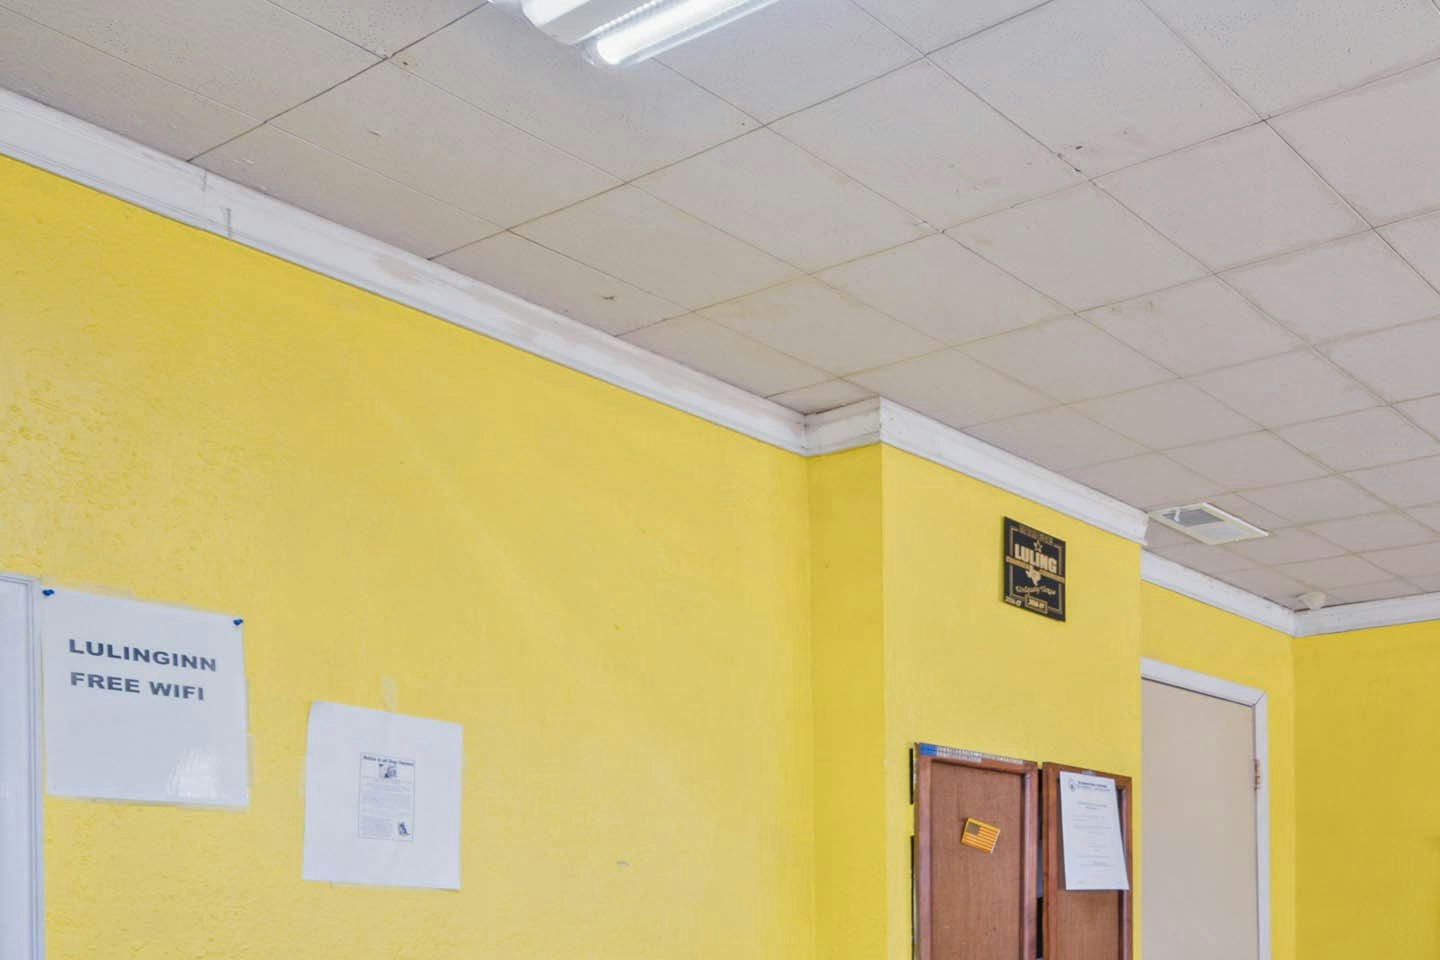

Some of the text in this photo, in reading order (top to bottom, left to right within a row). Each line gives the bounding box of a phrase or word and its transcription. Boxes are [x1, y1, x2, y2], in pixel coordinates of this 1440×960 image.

[1014, 543, 1058, 574] LULING
[68, 638, 217, 673] LULINGINN
[70, 671, 205, 702] FREE WIFI
